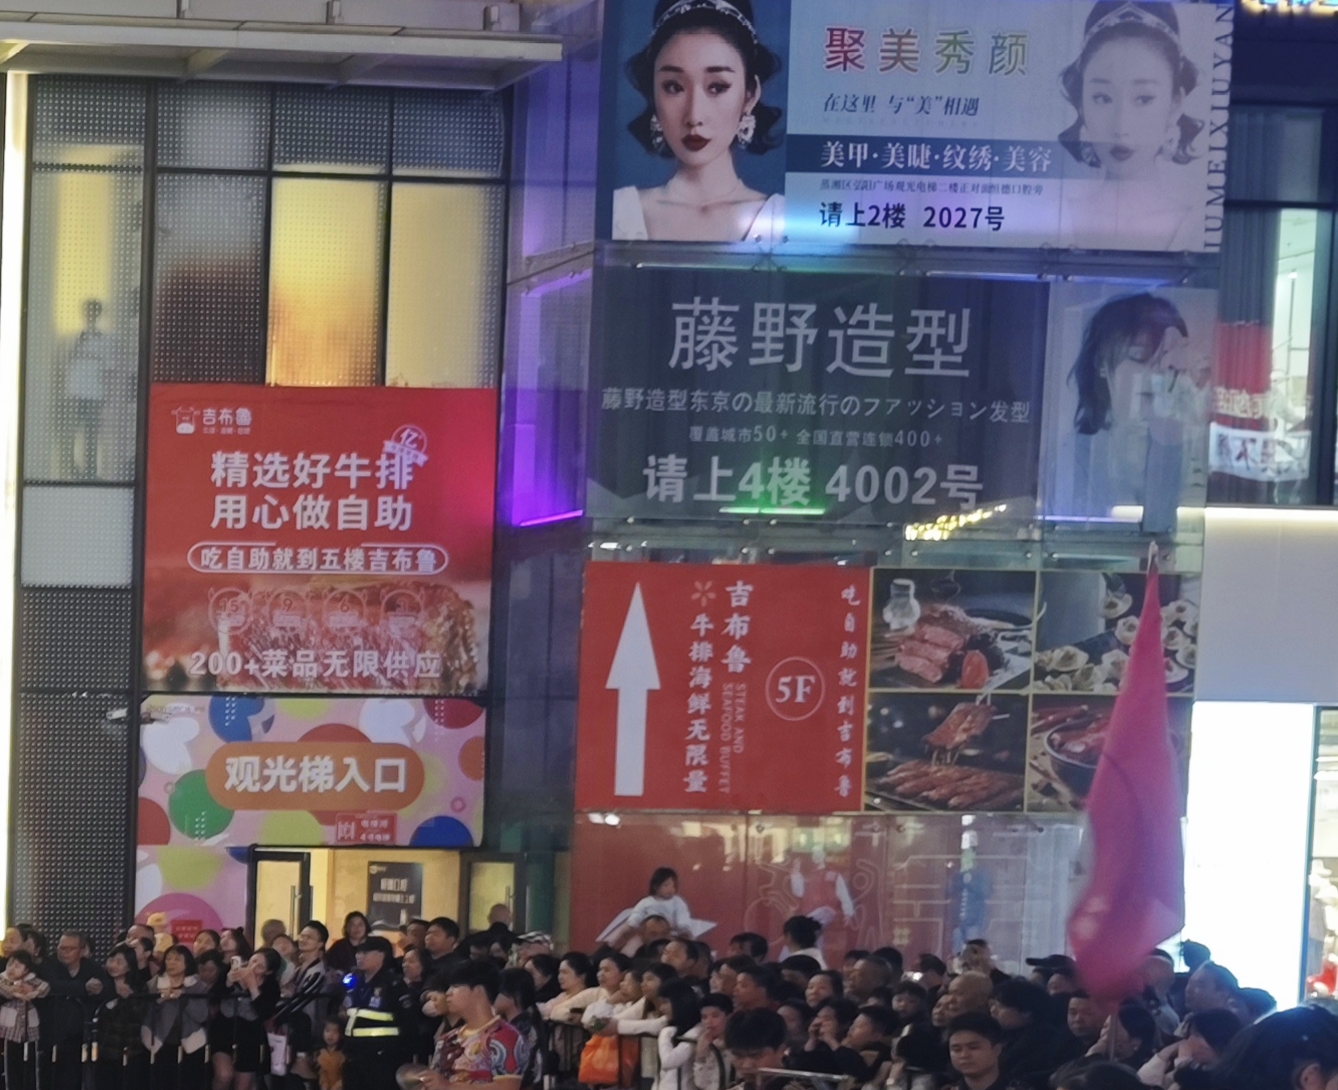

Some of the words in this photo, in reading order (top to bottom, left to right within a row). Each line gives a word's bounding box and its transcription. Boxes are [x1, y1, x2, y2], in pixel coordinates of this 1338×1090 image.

[824, 26, 1028, 76] 聚美秀颜
[823, 92, 876, 113] 在这里
[819, 202, 906, 229] 请上2楼
[922, 206, 1005, 231] 2027号
[669, 296, 973, 381] 藤野造型
[202, 407, 252, 426] 吉布鲁
[210, 450, 414, 490] 精选好牛排
[642, 452, 811, 506] 请上4楼
[825, 463, 983, 511] 4002号
[210, 494, 413, 531] 用心做自助
[200, 547, 437, 573] 吃自助就到五楼吉布鲁
[721, 580, 754, 673] 吉布鲁
[189, 649, 442, 680] 200+菜品无限供应
[683, 613, 715, 793] 牛排海鲜无限量
[775, 674, 815, 704] 5F
[834, 584, 862, 798] 吃自助就到吉布鲁
[224, 755, 407, 794] 观光梯入口
